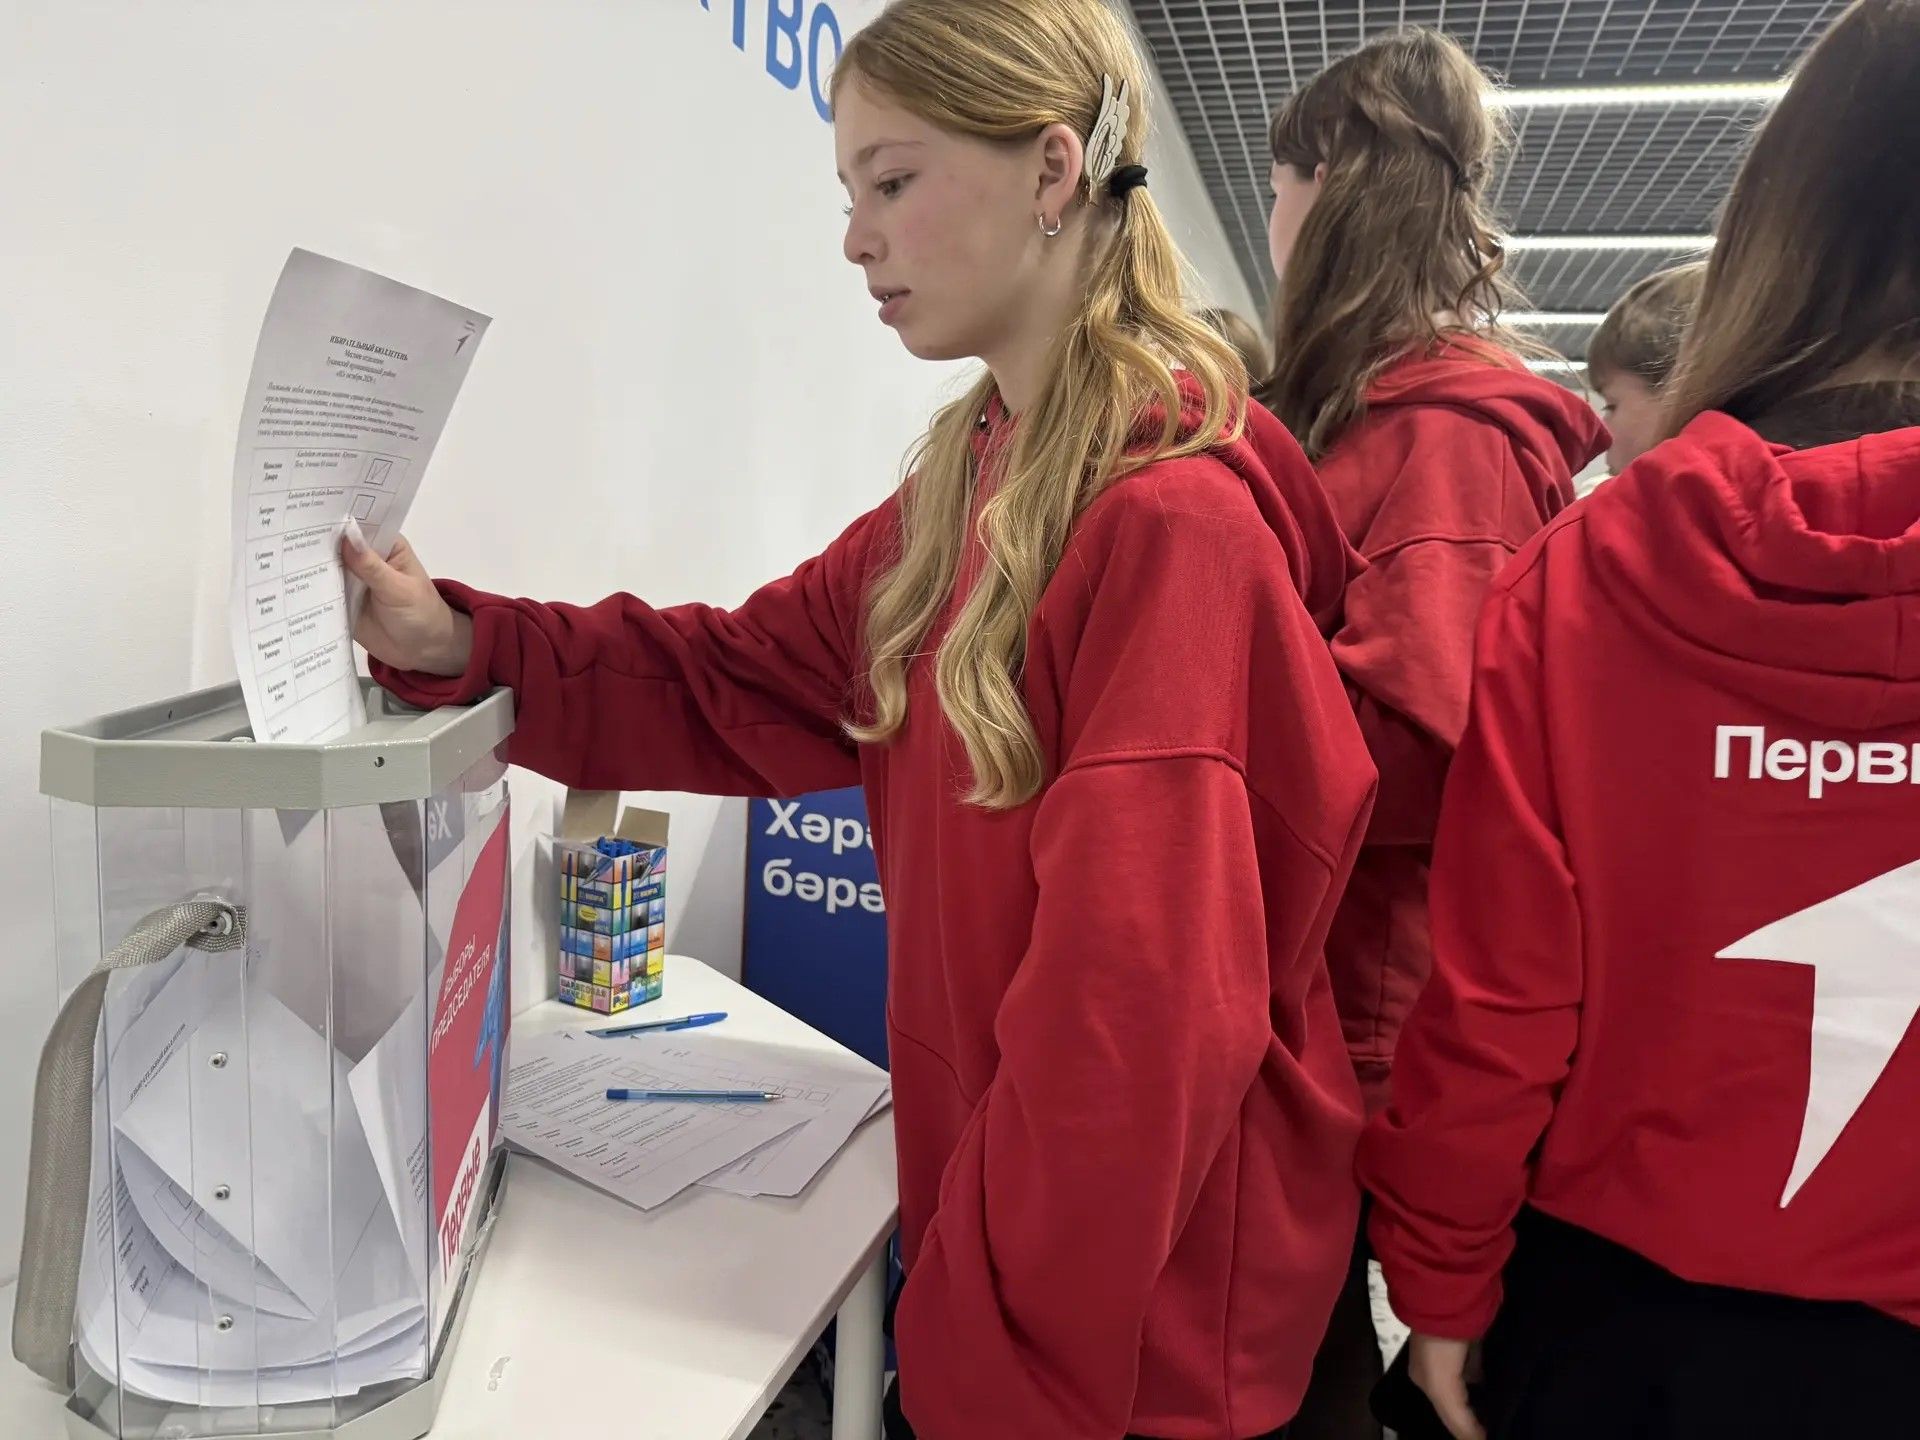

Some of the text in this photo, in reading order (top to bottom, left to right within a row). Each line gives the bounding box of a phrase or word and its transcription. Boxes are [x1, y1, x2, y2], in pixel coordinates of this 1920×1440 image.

[765, 798, 874, 855] Хәр
[431, 943, 490, 1055] ПРЕДСЕДАТЕЛЯ
[443, 933, 476, 1001] ВЫБОРЫ
[442, 1135, 482, 1284] Первые
